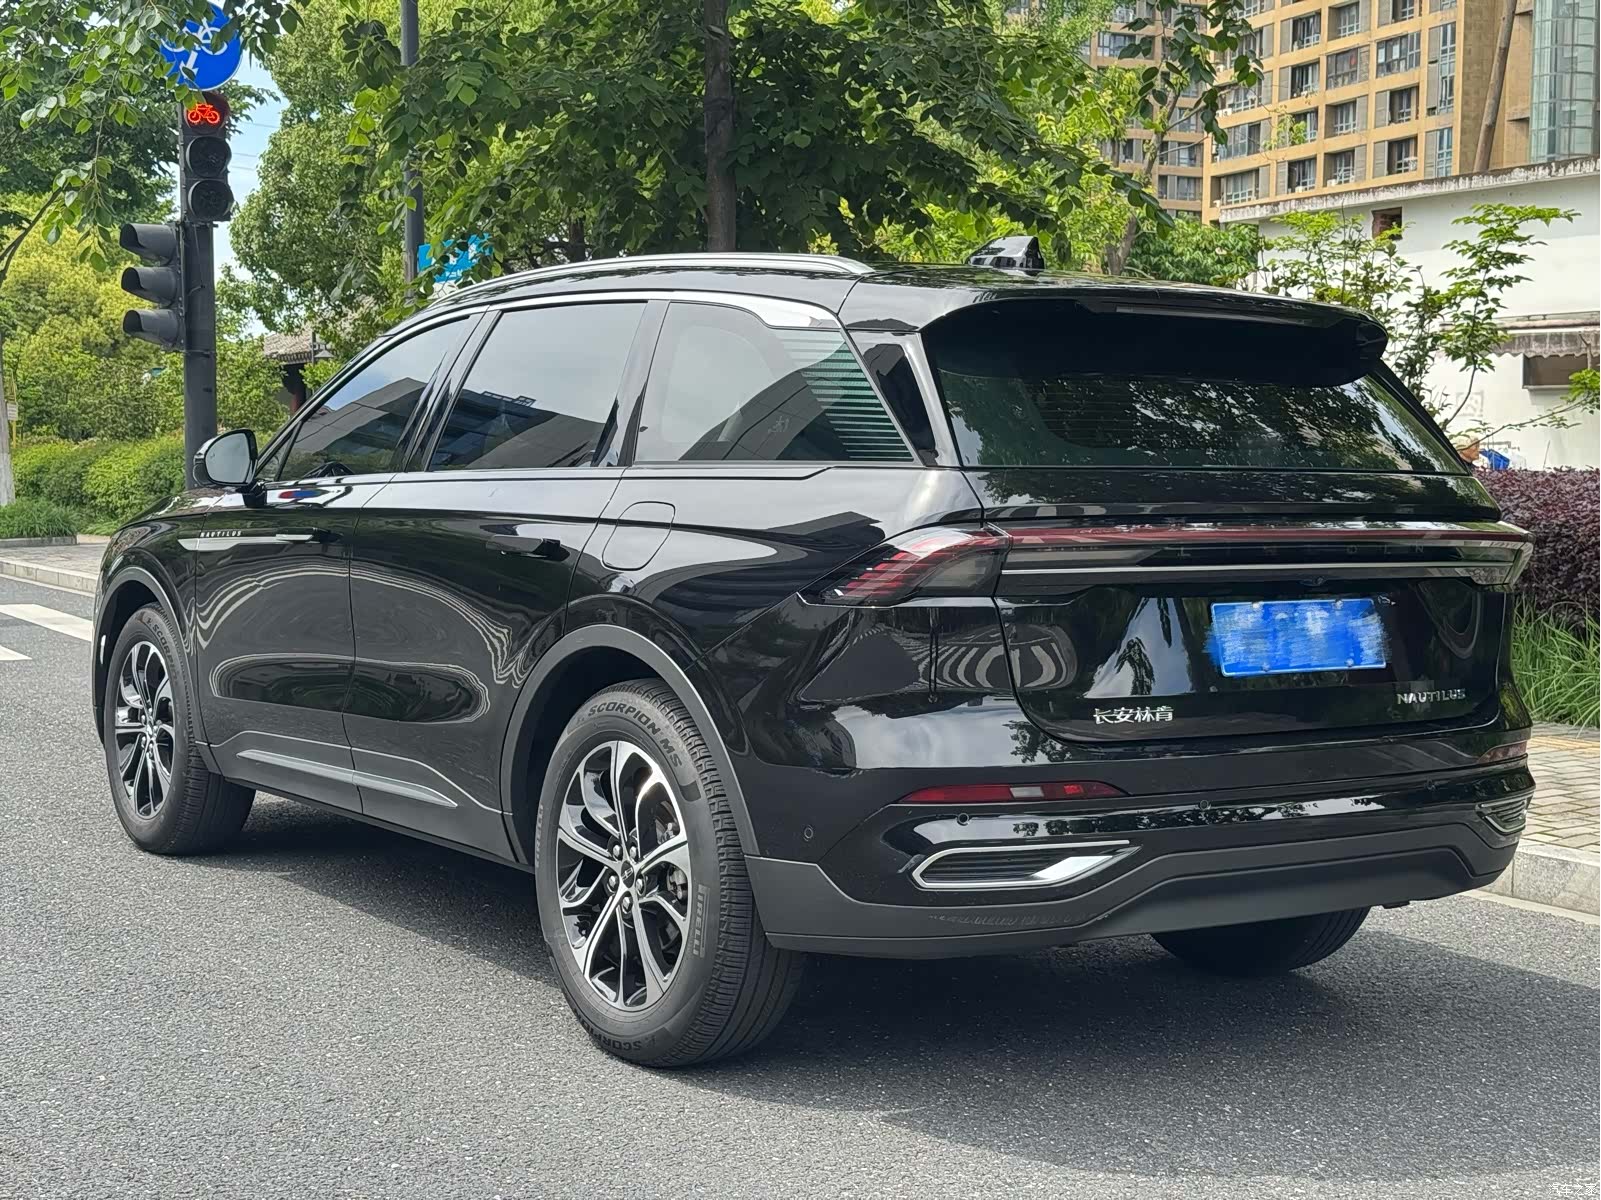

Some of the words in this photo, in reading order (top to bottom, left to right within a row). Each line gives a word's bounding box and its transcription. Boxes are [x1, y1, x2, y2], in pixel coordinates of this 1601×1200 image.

[200, 530, 242, 538] NAUTILUS
[1396, 688, 1466, 704] NAUTILUS
[588, 702, 662, 735] SCORPION
[1093, 706, 1174, 724] 长安林肯
